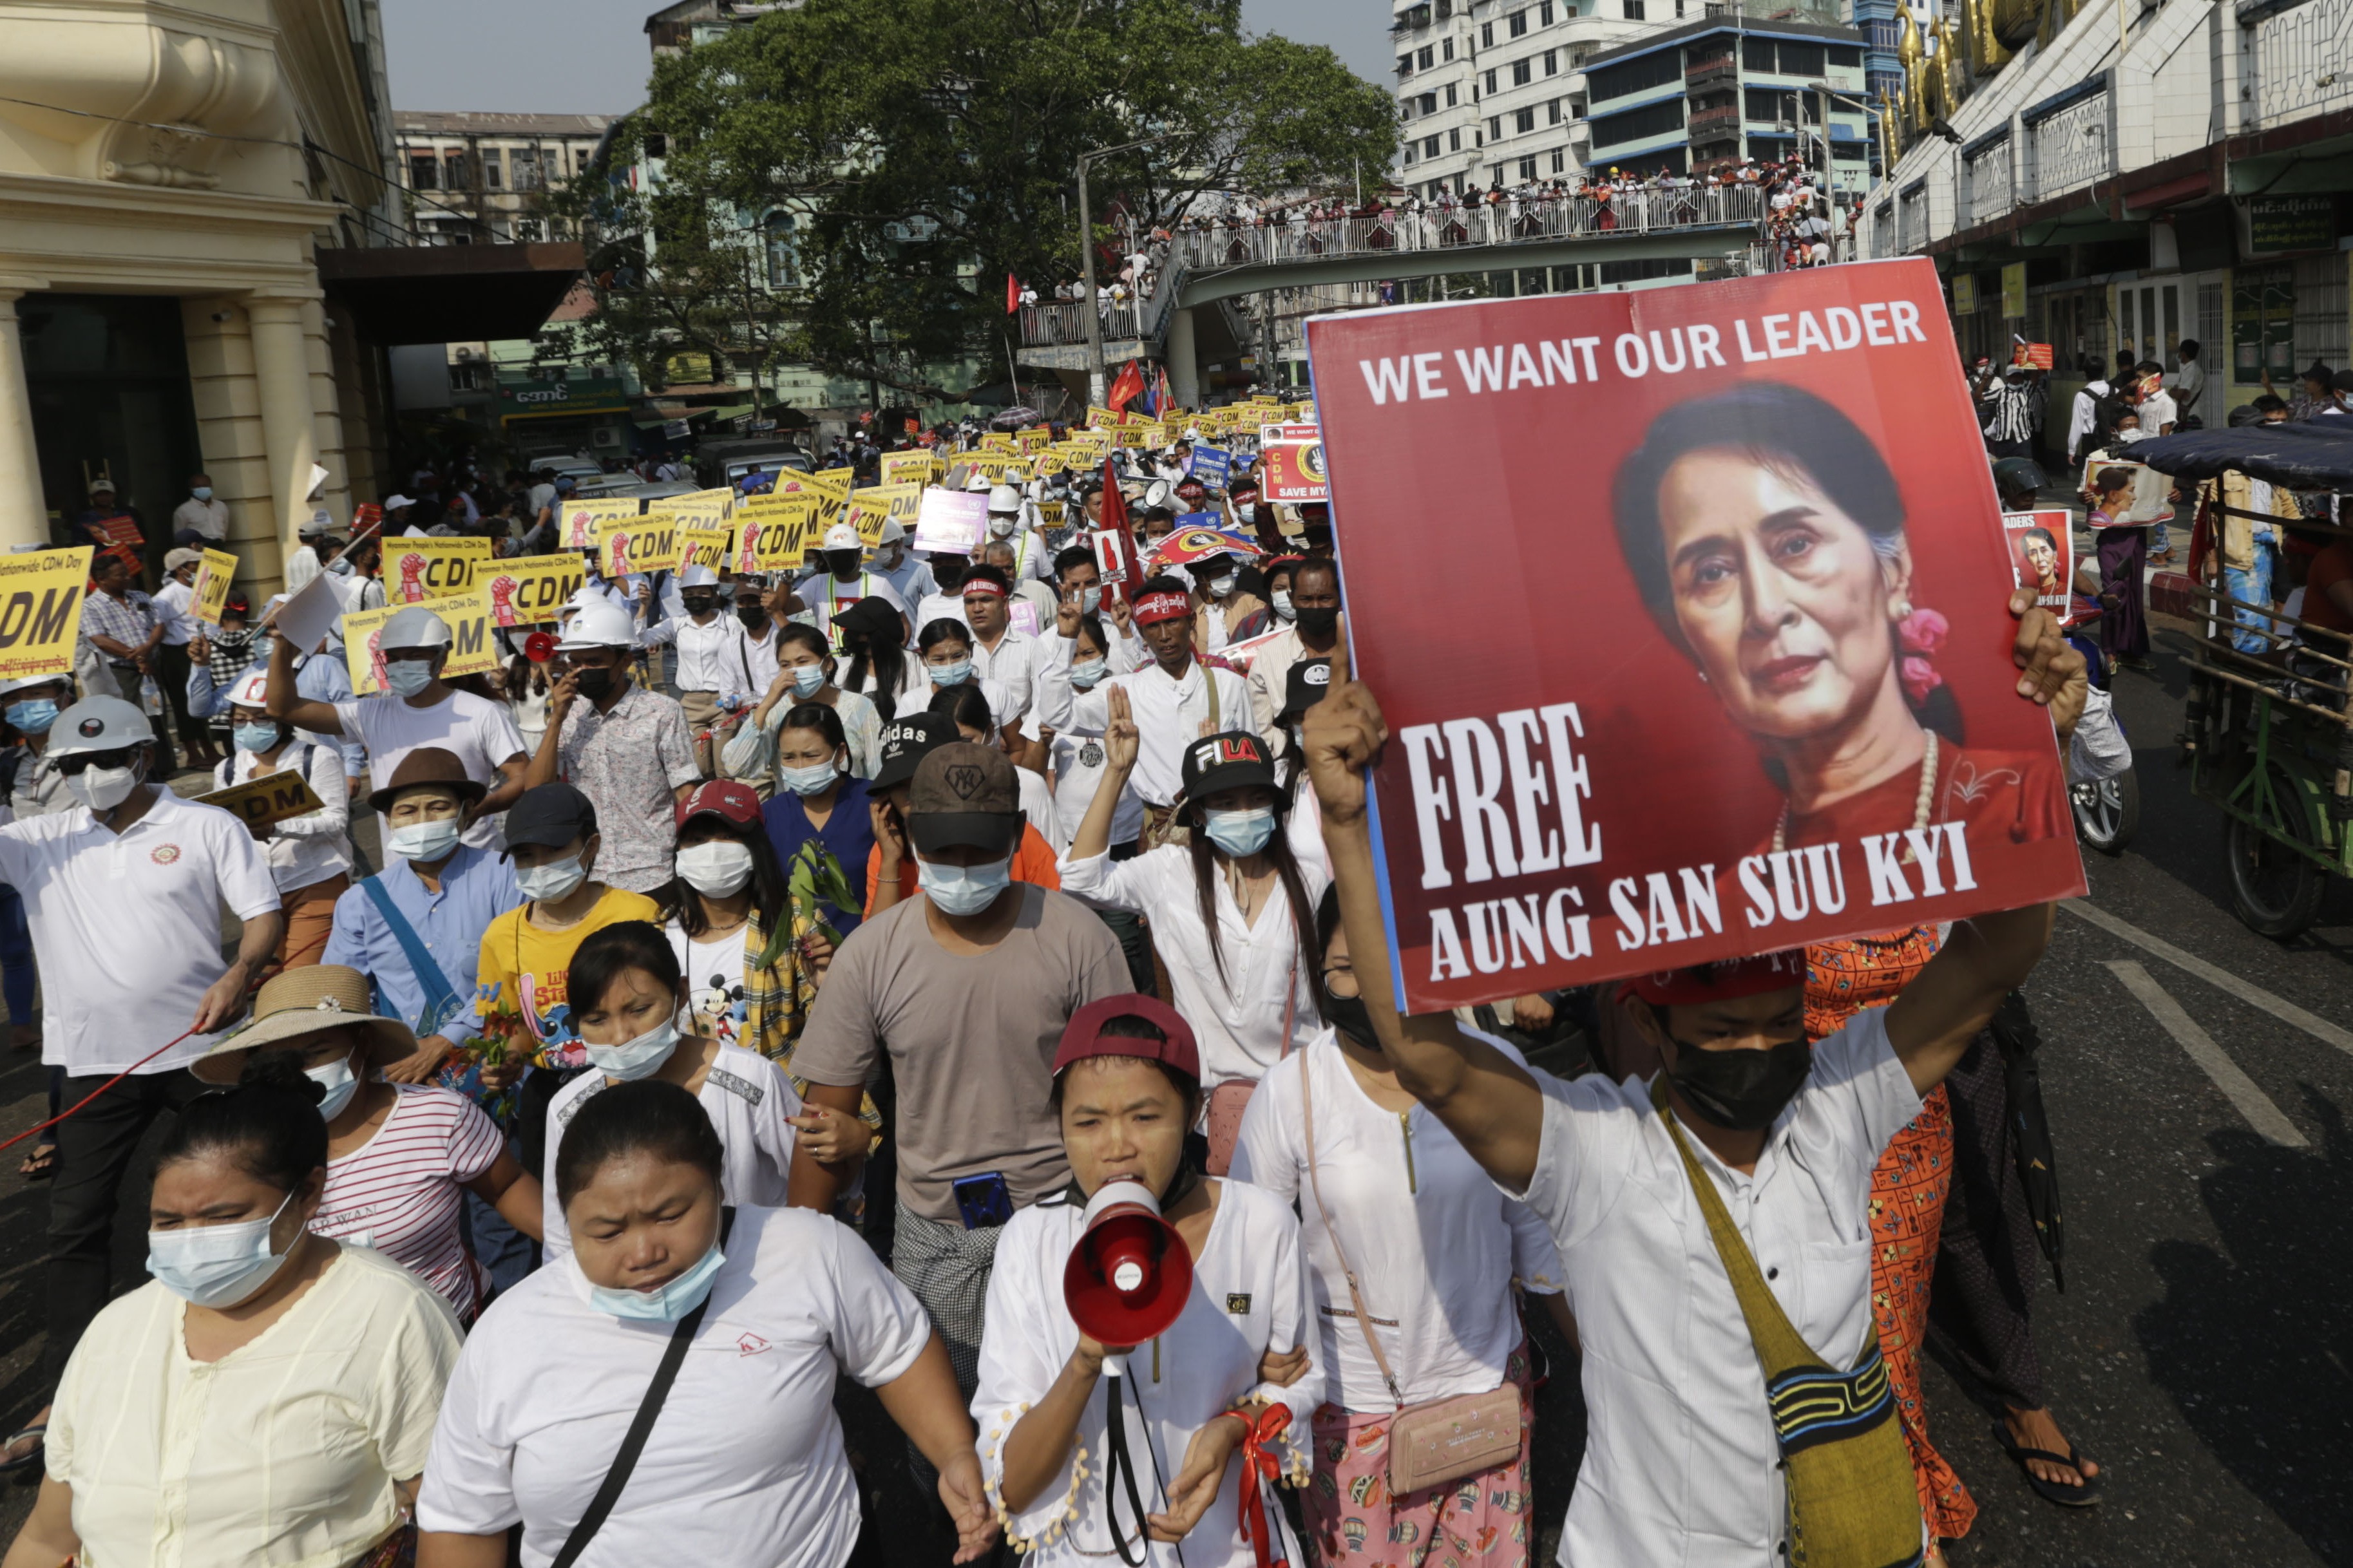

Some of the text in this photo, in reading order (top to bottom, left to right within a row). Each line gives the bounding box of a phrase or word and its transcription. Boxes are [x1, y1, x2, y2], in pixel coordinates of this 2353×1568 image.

[1359, 301, 1927, 405] WE WANT OUR LEADER
[517, 383, 567, 402] အောင်
[1098, 415, 1117, 426] CDM
[1222, 412, 1239, 422] CDM
[1199, 422, 1217, 433] CDM
[1242, 420, 1260, 429] CDM
[1029, 437, 1048, 449] CDM
[1123, 433, 1141, 442] CDM
[1045, 457, 1065, 469] CDM
[1069, 451, 1092, 464] CDM
[931, 469, 944, 484] DM
[979, 464, 1005, 478] CDM
[1279, 487, 1307, 496] SAVE
[890, 495, 919, 516] DM
[1040, 510, 1063, 522] DM
[2005, 515, 2035, 529] ADERS
[855, 511, 886, 536] CDM
[477, 541, 487, 550] Day
[629, 529, 674, 560] CDM
[757, 522, 804, 555] CDM
[555, 558, 568, 567] CDM
[569, 557, 580, 566] Day
[692, 545, 723, 567] CDM
[0, 554, 82, 576] ationwide CDM Day
[201, 573, 230, 607] CDM
[448, 600, 466, 610] CDM
[466, 598, 481, 609] Day
[2055, 594, 2066, 605] KYI
[0, 586, 80, 649] DM
[348, 616, 379, 629] Myanmar
[1195, 737, 1261, 773] FILA
[223, 783, 306, 820] DM
[1400, 702, 1602, 890] FREE
[1429, 820, 1977, 981] AUNG SAN SUU KYI
[336, 1204, 377, 1227] WAN
